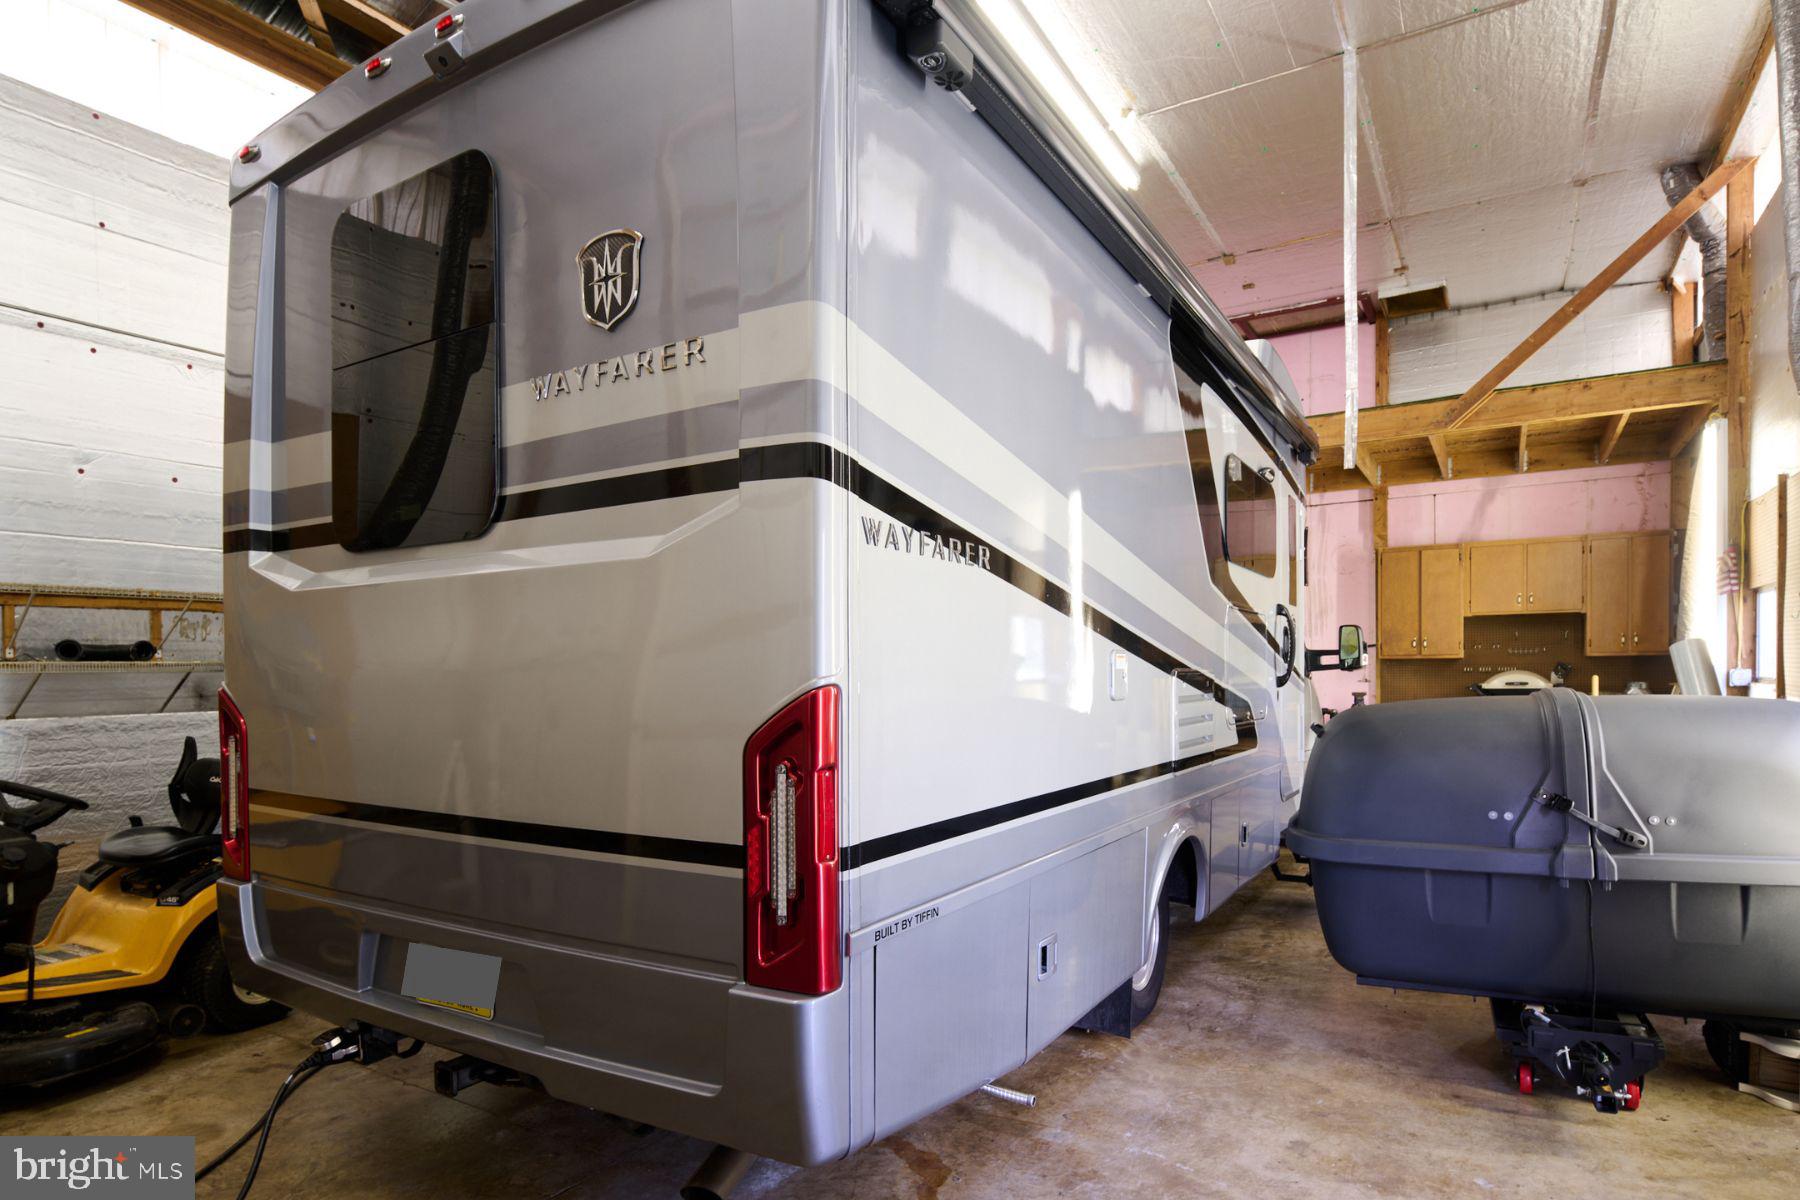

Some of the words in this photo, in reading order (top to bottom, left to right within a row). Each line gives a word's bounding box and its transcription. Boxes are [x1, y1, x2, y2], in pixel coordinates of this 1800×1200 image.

[530, 336, 706, 401] WAYFARER
[861, 516, 991, 570] WAYFARER
[874, 922, 899, 942] BUILT
[901, 917, 912, 931] BY
[914, 907, 939, 924] TIFFIN
